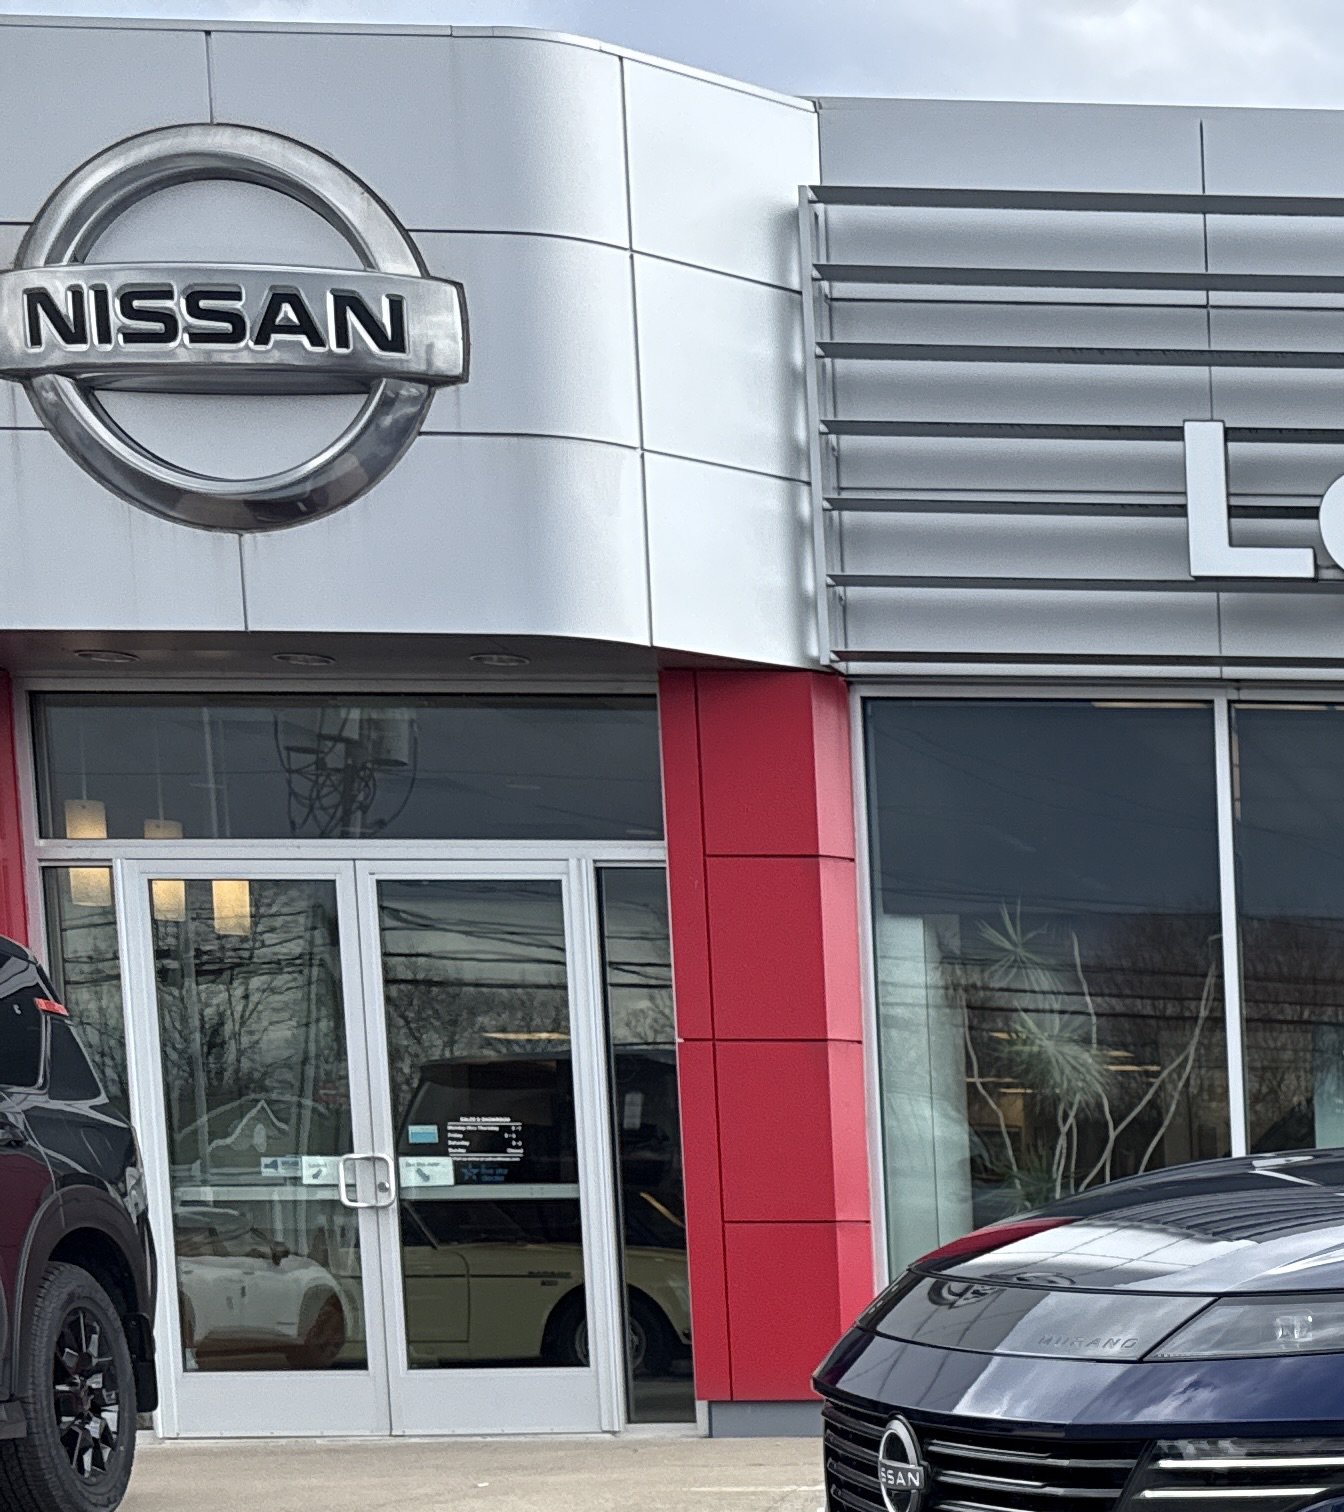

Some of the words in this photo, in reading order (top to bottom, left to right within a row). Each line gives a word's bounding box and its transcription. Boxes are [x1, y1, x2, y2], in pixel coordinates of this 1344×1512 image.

[22, 282, 409, 356] NISSAN
[1037, 1335, 1138, 1349] MURANO
[880, 1467, 920, 1487] SSAN
